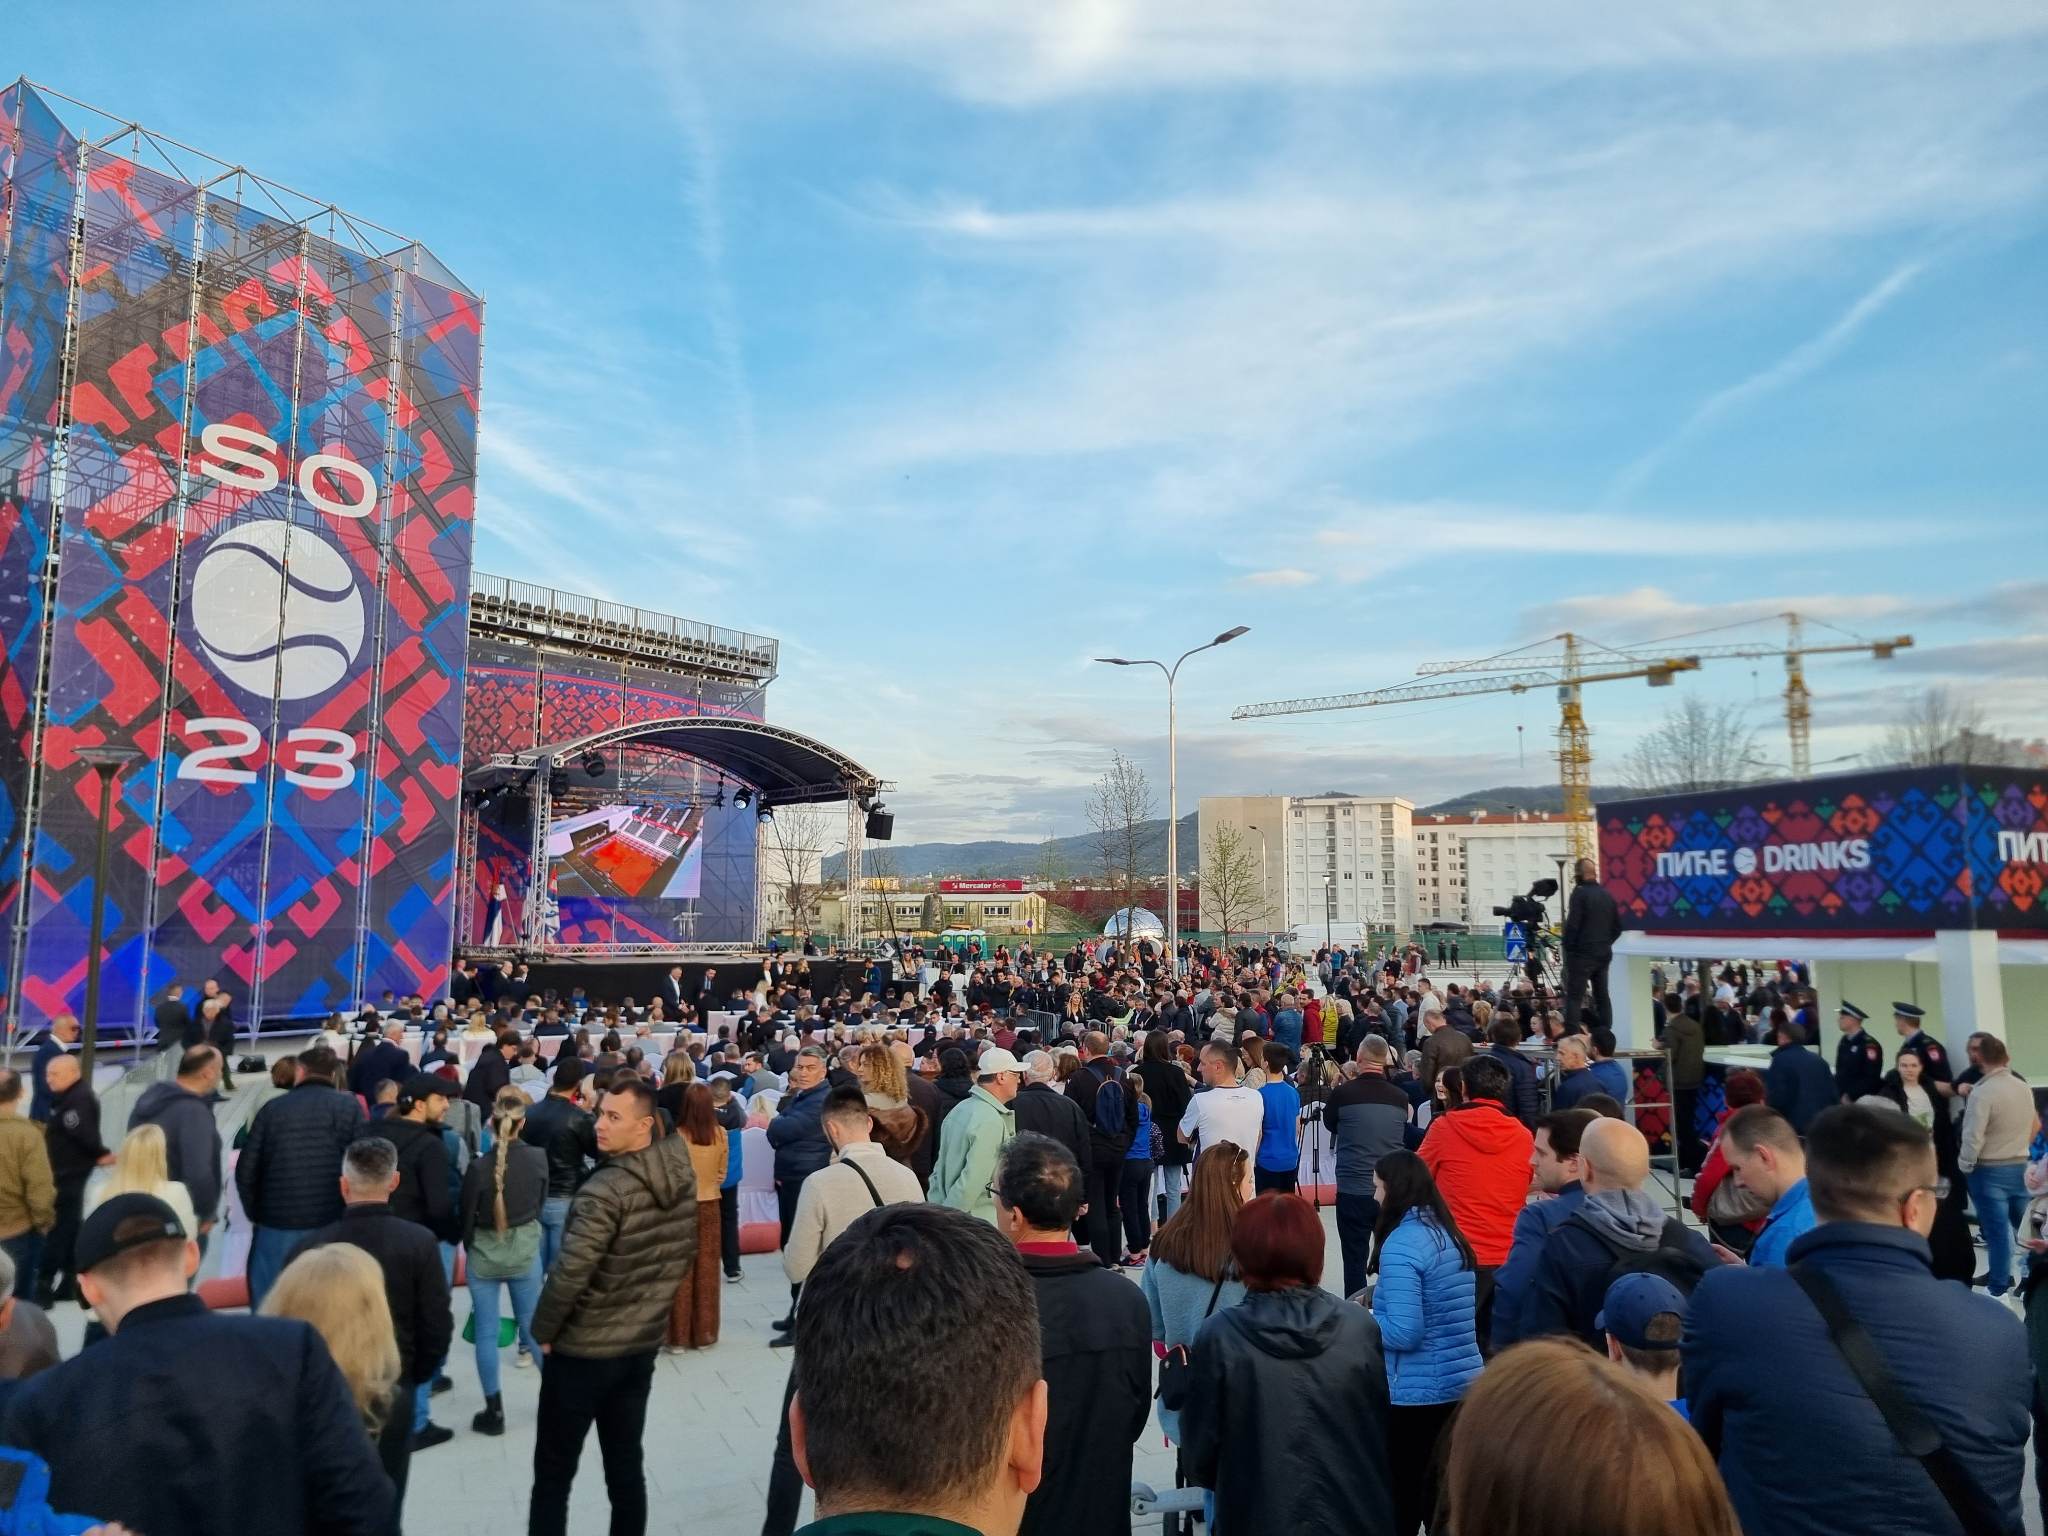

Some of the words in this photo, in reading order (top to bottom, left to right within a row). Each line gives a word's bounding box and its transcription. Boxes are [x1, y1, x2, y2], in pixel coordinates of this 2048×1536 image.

[201, 423, 378, 518] SO
[177, 717, 357, 789] 23
[1656, 848, 1728, 877] ПИЋЕ
[1763, 839, 1871, 873] DRINKS
